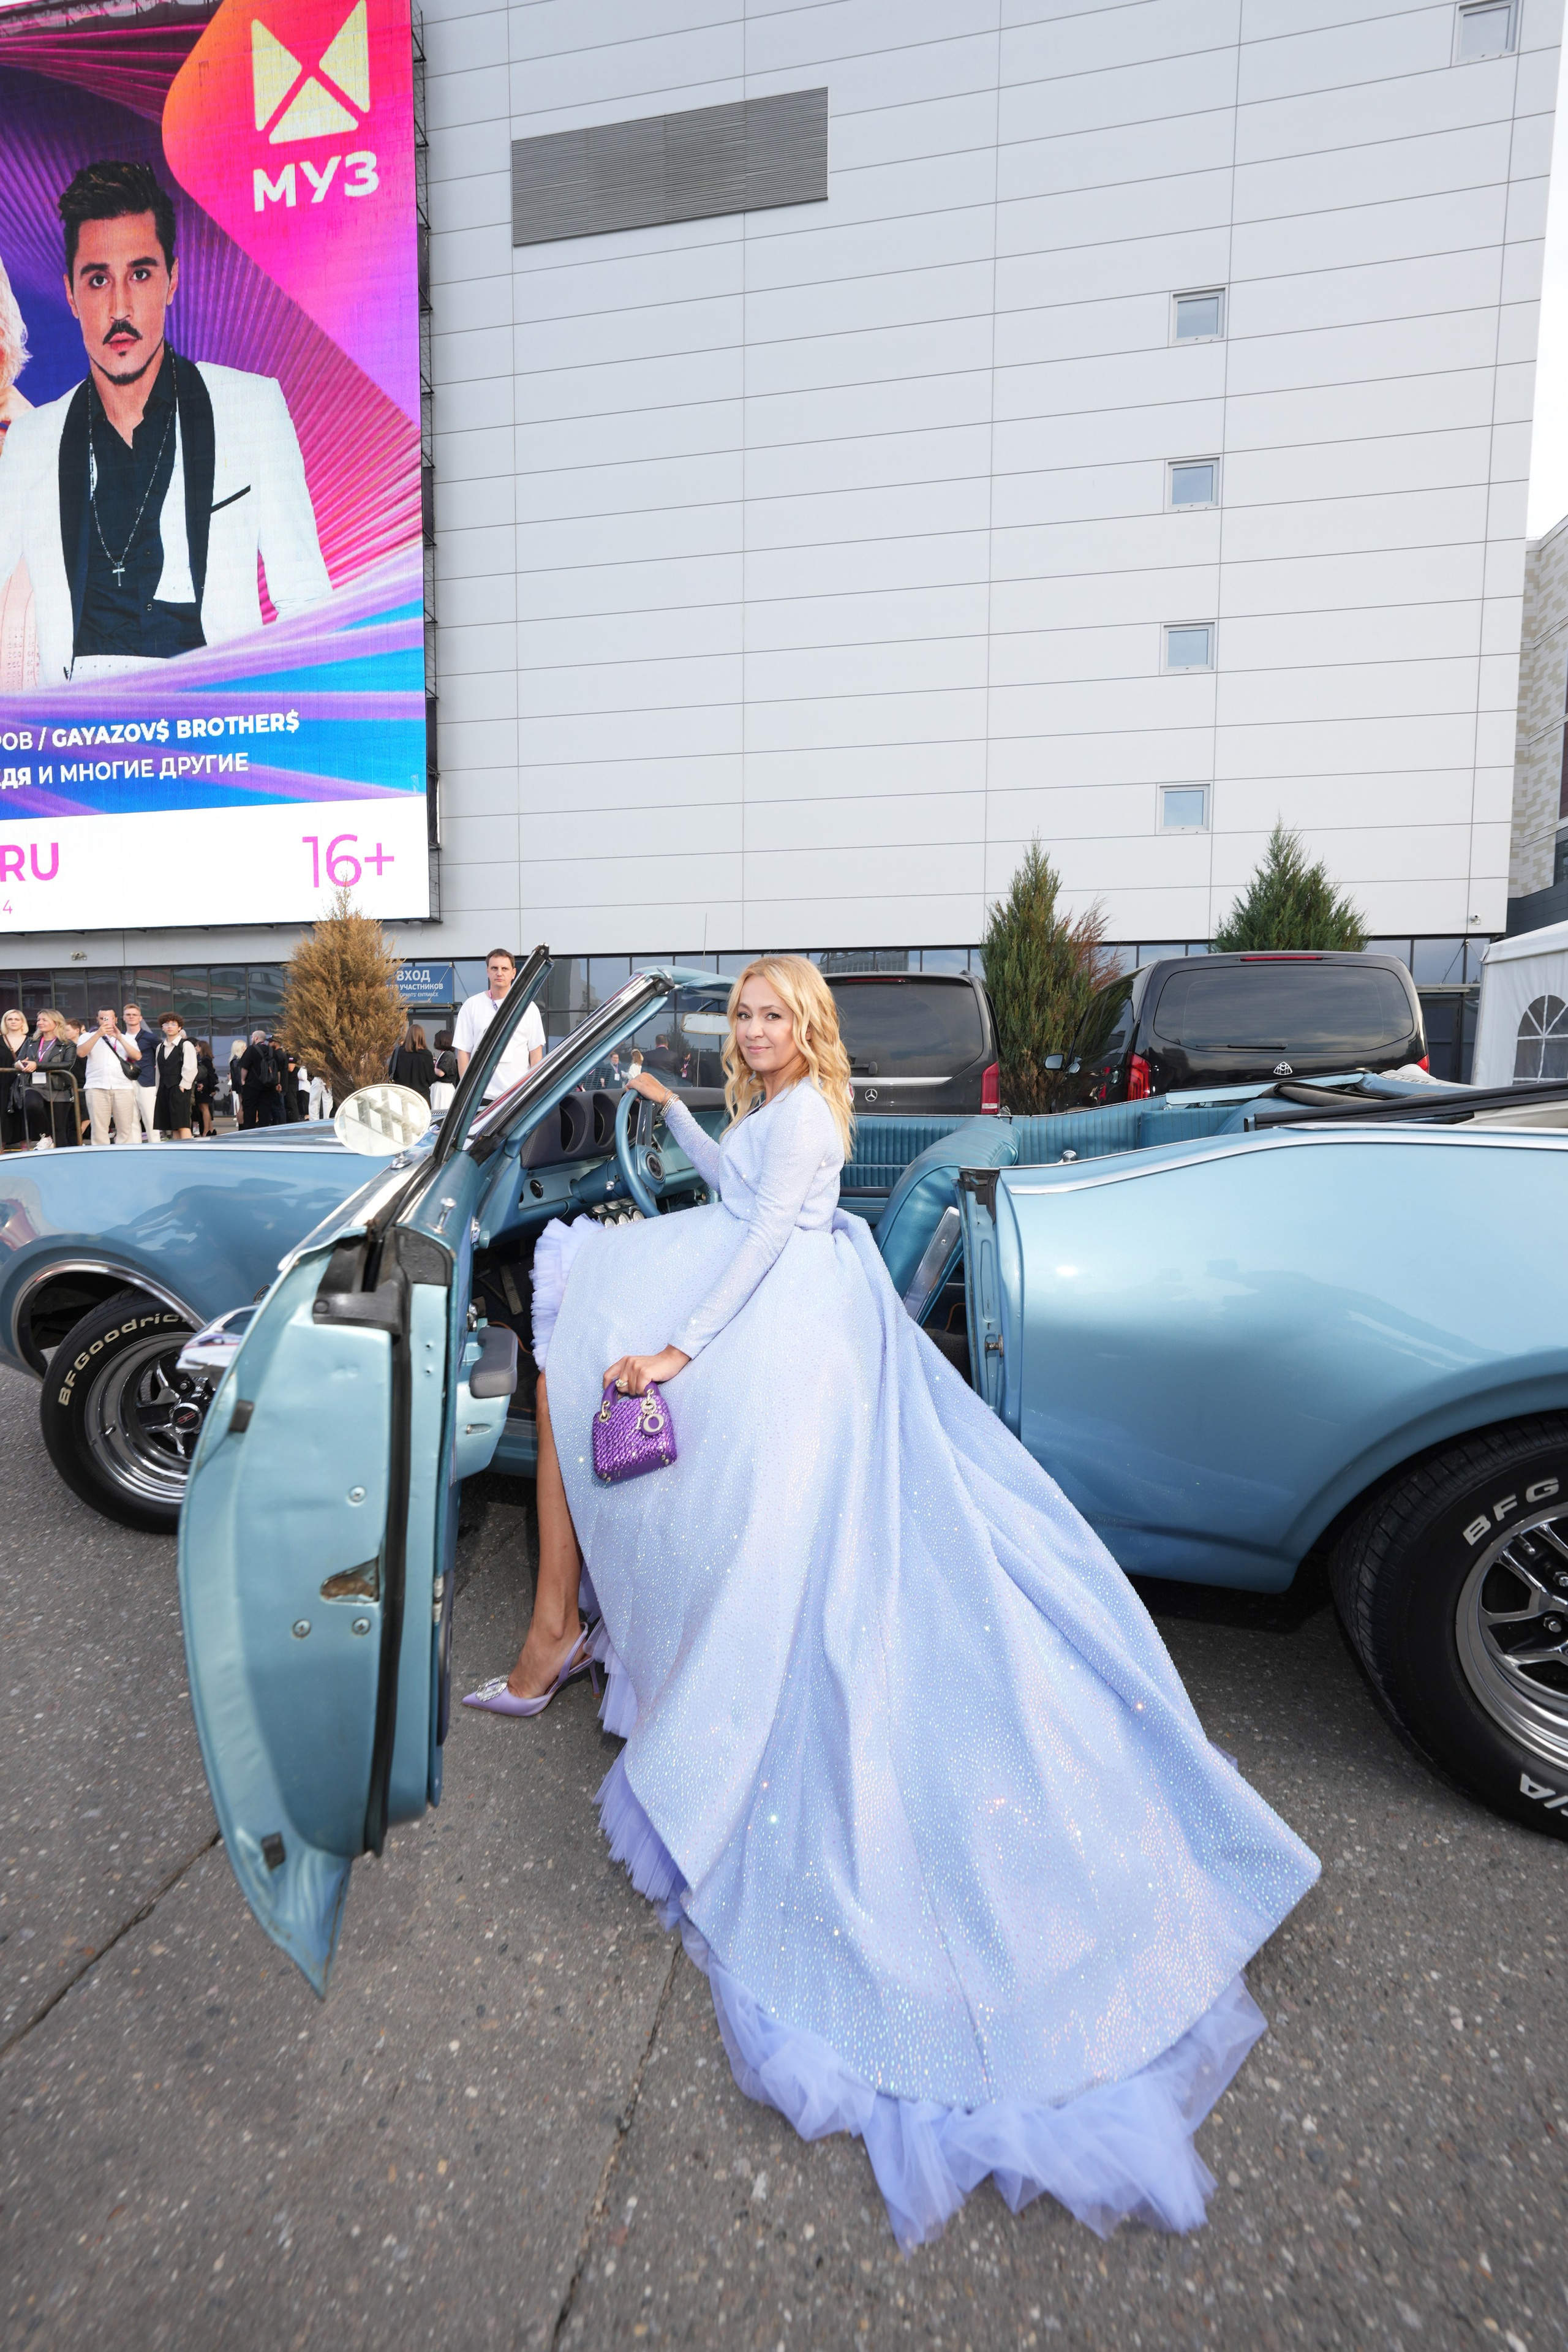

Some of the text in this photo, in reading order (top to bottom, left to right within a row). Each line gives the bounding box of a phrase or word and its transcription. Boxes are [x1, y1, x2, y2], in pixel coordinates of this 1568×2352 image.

[253, 150, 380, 212] МУЗ
[51, 718, 170, 748] GAYAZOV$
[176, 709, 300, 739] BROTHER$
[0, 752, 249, 790] ДЯ И МНОГИЕ ДРУГИЕ
[302, 834, 394, 888] 16+
[396, 970, 431, 982] ВХОД
[58, 1313, 187, 1406] BFGoodric
